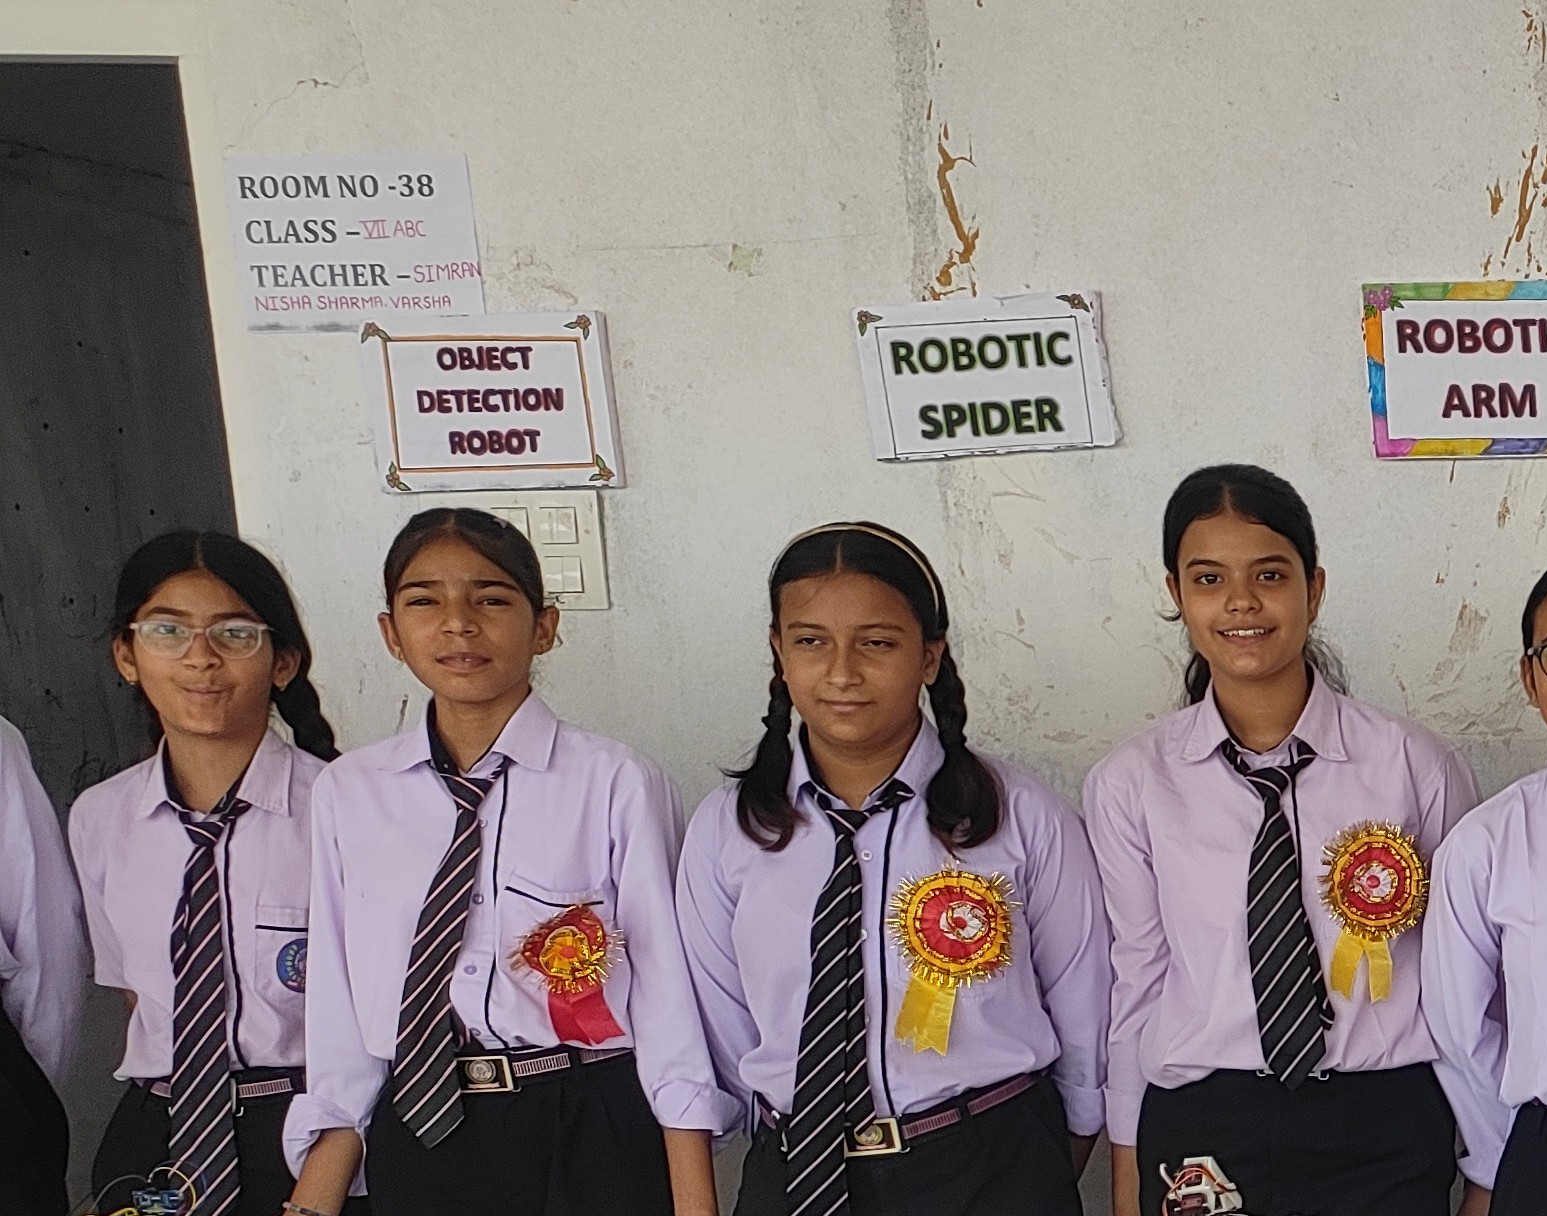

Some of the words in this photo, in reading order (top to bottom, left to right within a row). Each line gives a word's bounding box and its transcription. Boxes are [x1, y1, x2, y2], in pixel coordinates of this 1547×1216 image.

[238, 175, 330, 199] ROOM
[337, 174, 379, 198] NO
[245, 219, 337, 244] CLASS
[393, 219, 427, 238] ABC
[250, 263, 390, 288] TEACHER
[414, 261, 482, 283] SIMRAN
[255, 294, 312, 312] NISHA
[390, 295, 452, 310] VARSHA
[436, 345, 533, 371] OBJECT
[889, 331, 1073, 376] ROBOTIC
[416, 387, 564, 414] DETECTION
[1441, 382, 1538, 419] ARM
[918, 396, 1065, 440] SPIDER
[448, 429, 541, 456] ROBOT
